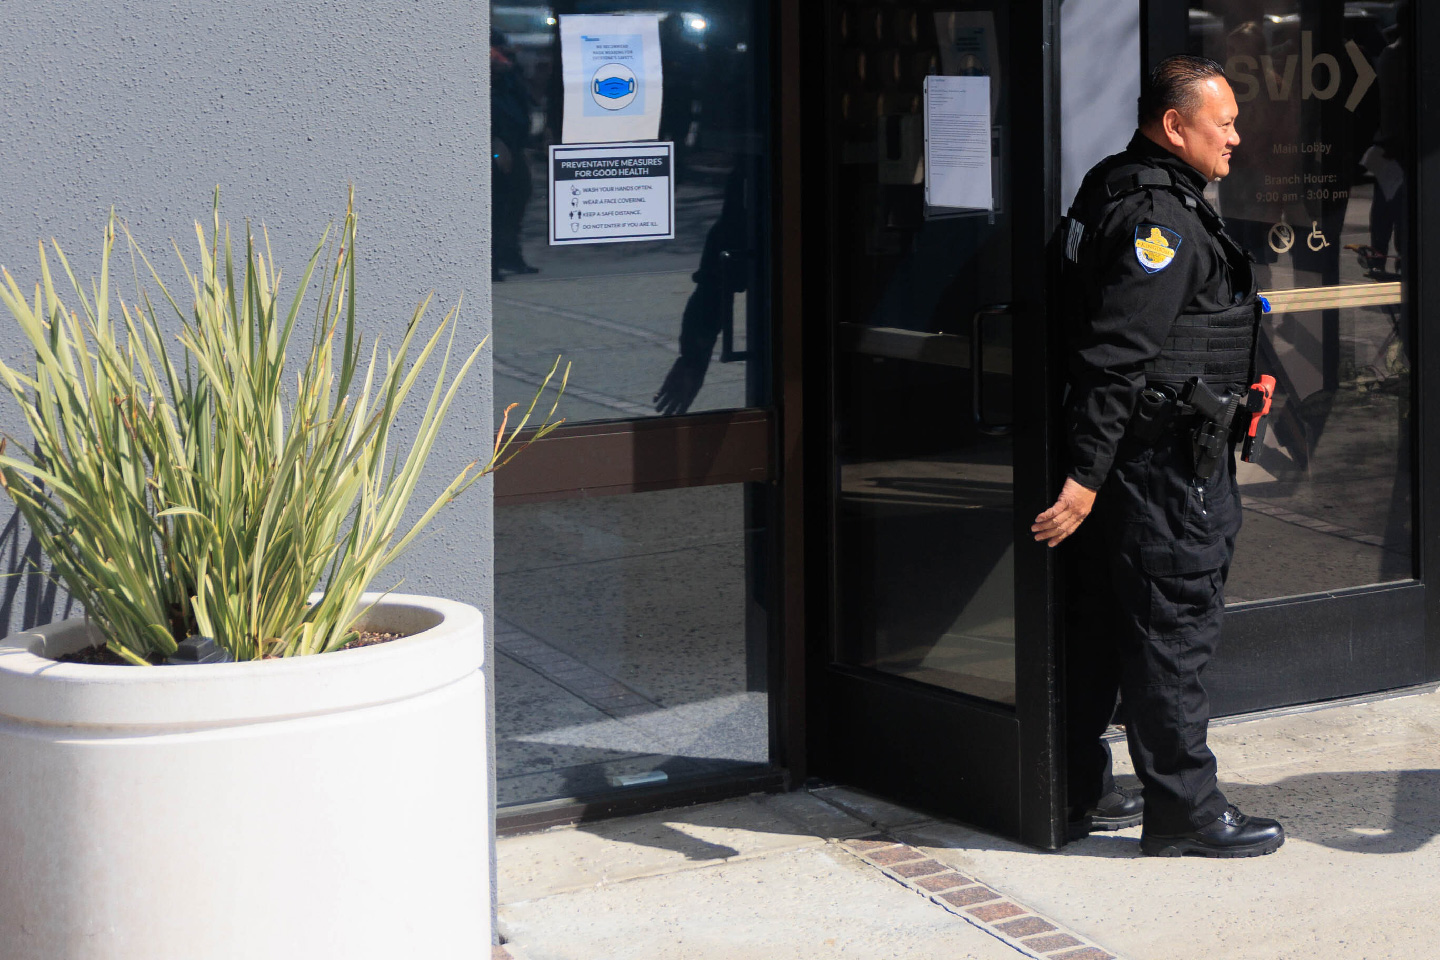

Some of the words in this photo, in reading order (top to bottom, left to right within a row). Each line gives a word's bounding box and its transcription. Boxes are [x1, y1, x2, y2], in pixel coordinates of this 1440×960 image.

[1224, 30, 1341, 103] svb
[1272, 143, 1298, 155] Main
[1301, 142, 1332, 156] Lobby
[561, 159, 620, 169] PREVENTATIVE
[620, 158, 663, 166] MEASURES
[574, 170, 592, 178] FOR
[592, 169, 619, 177] GOOD
[620, 167, 649, 176] HEALTH
[1264, 174, 1300, 185] Branch
[1303, 173, 1337, 184] Hours:
[1255, 192, 1279, 202] 9:00
[1281, 193, 1298, 202] am
[1306, 189, 1329, 200] 3:00
[1332, 191, 1348, 202] pm
